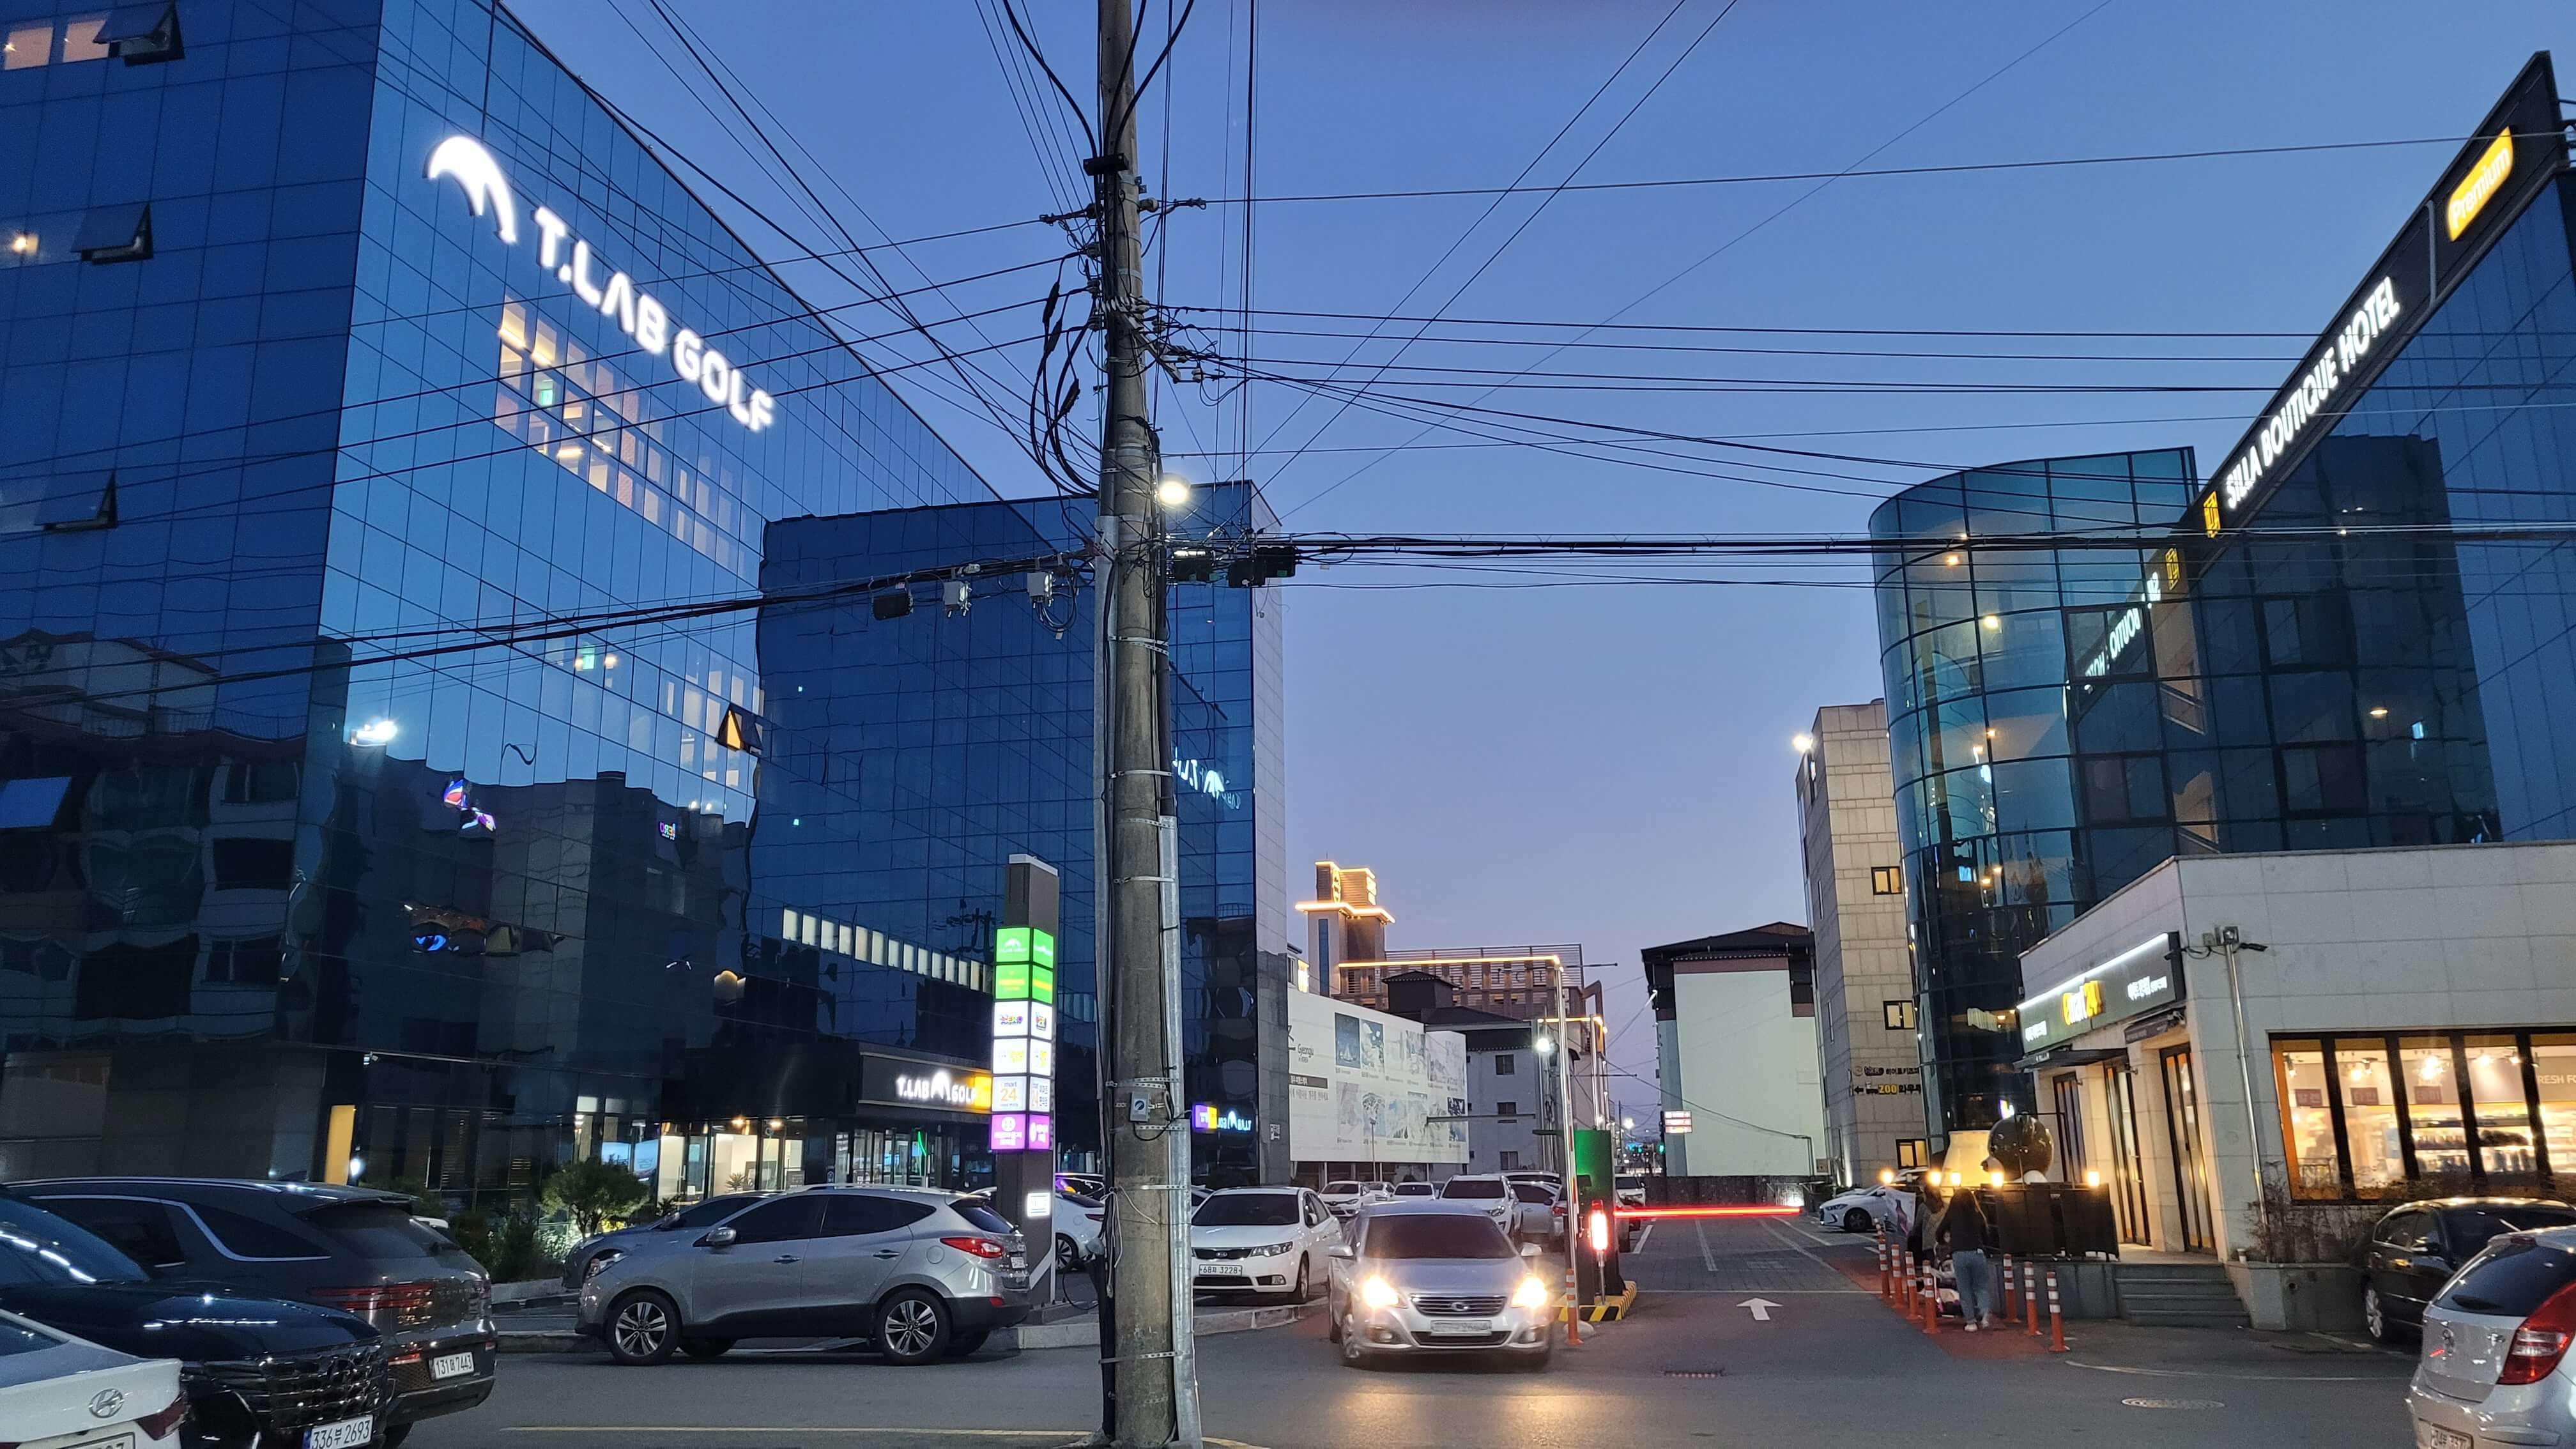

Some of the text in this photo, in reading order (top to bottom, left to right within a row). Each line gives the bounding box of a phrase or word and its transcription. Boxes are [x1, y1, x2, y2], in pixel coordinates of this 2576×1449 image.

[2450, 148, 2511, 228] Premium
[532, 206, 774, 433] T.LAB GOLF
[2225, 276, 2400, 509] SILLA BOUTIQUE HOTEL
[896, 1075, 930, 1100] T.LAB
[1001, 1088, 1017, 1102] 24
[2537, 1075, 2564, 1084] RESH
